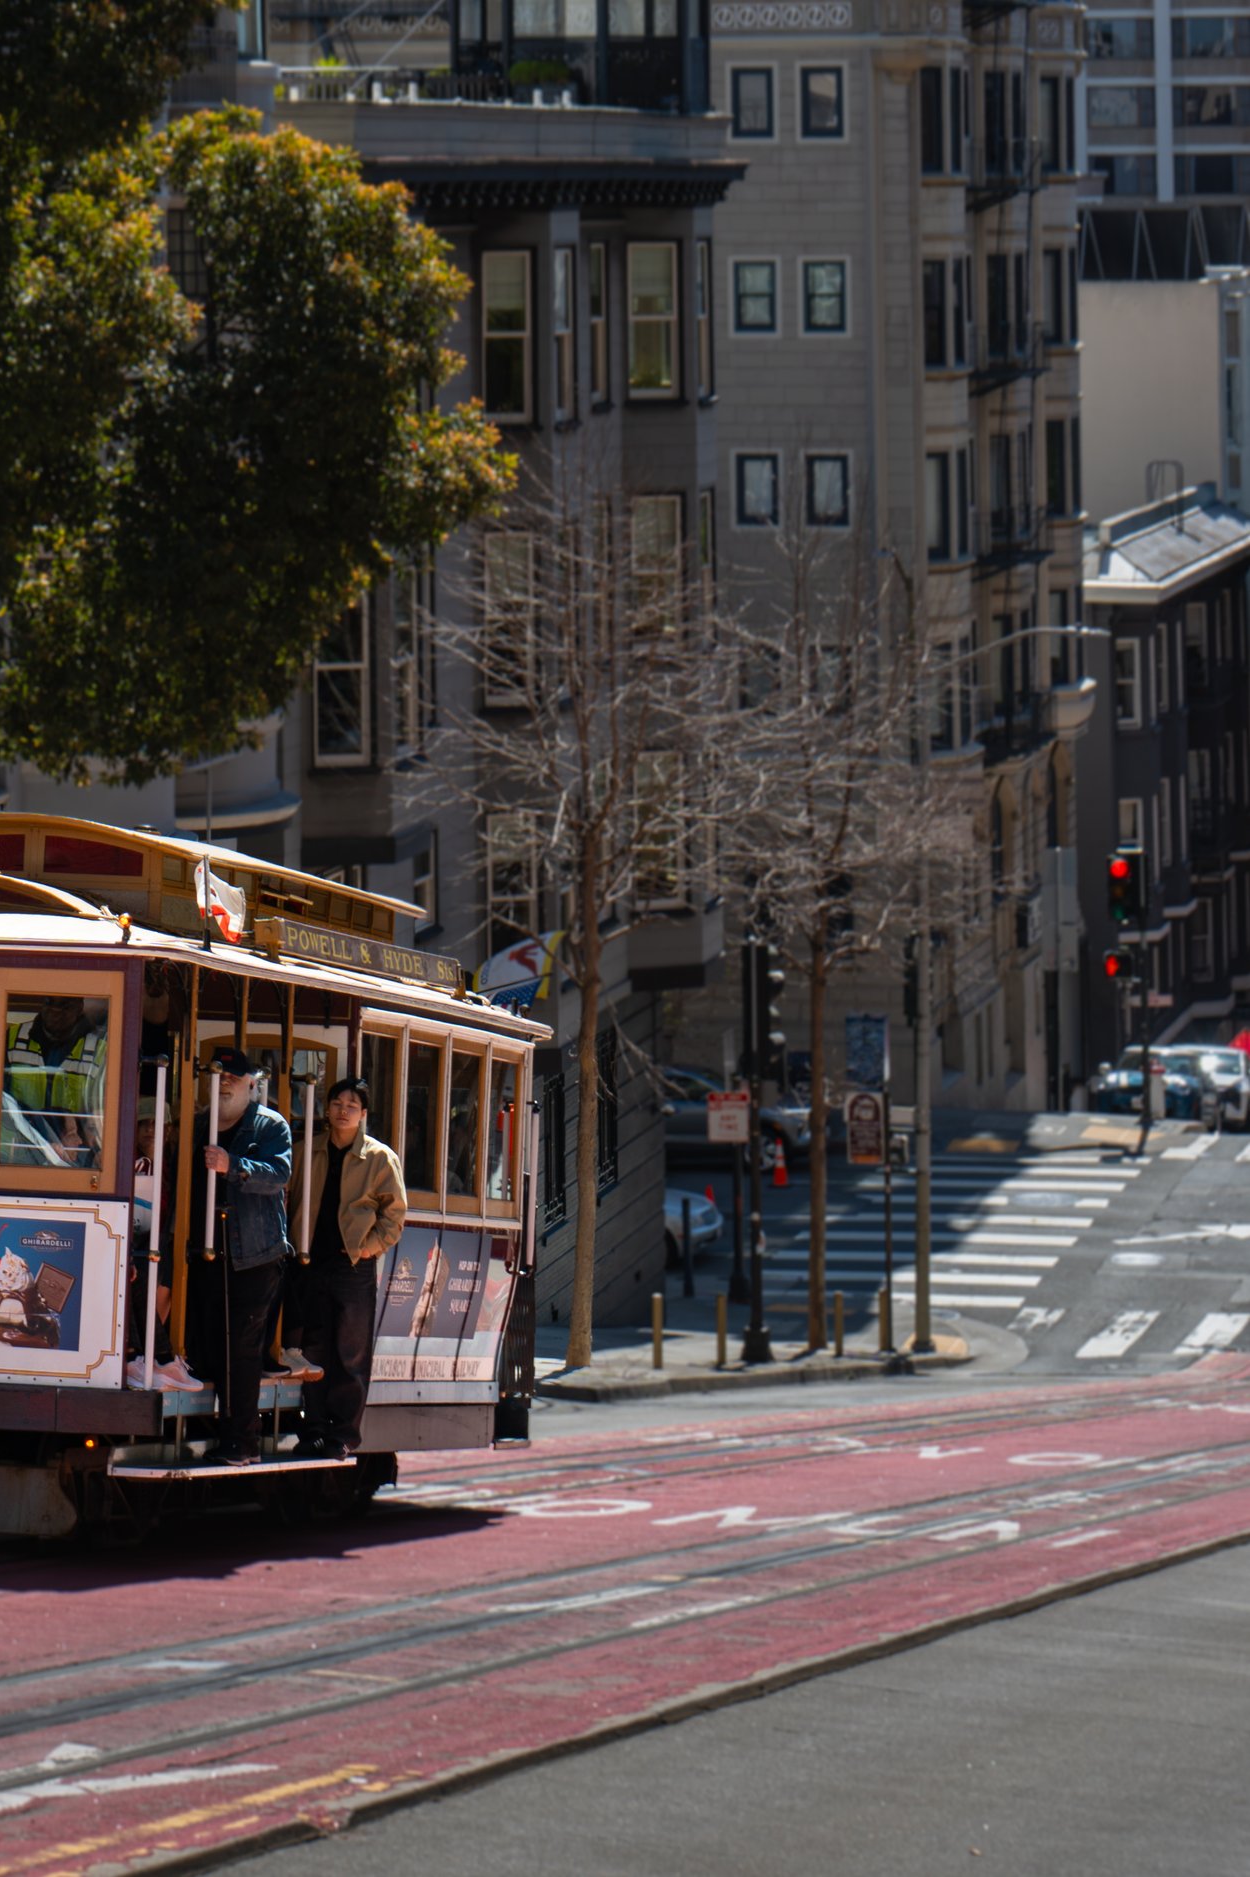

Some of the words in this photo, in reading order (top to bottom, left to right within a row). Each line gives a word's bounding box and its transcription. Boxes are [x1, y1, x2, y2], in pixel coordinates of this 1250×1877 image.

[286, 926, 353, 961] POWELL
[359, 942, 372, 964] &
[382, 948, 425, 976] HYDE
[21, 1238, 71, 1247] GHIRARDELLI
